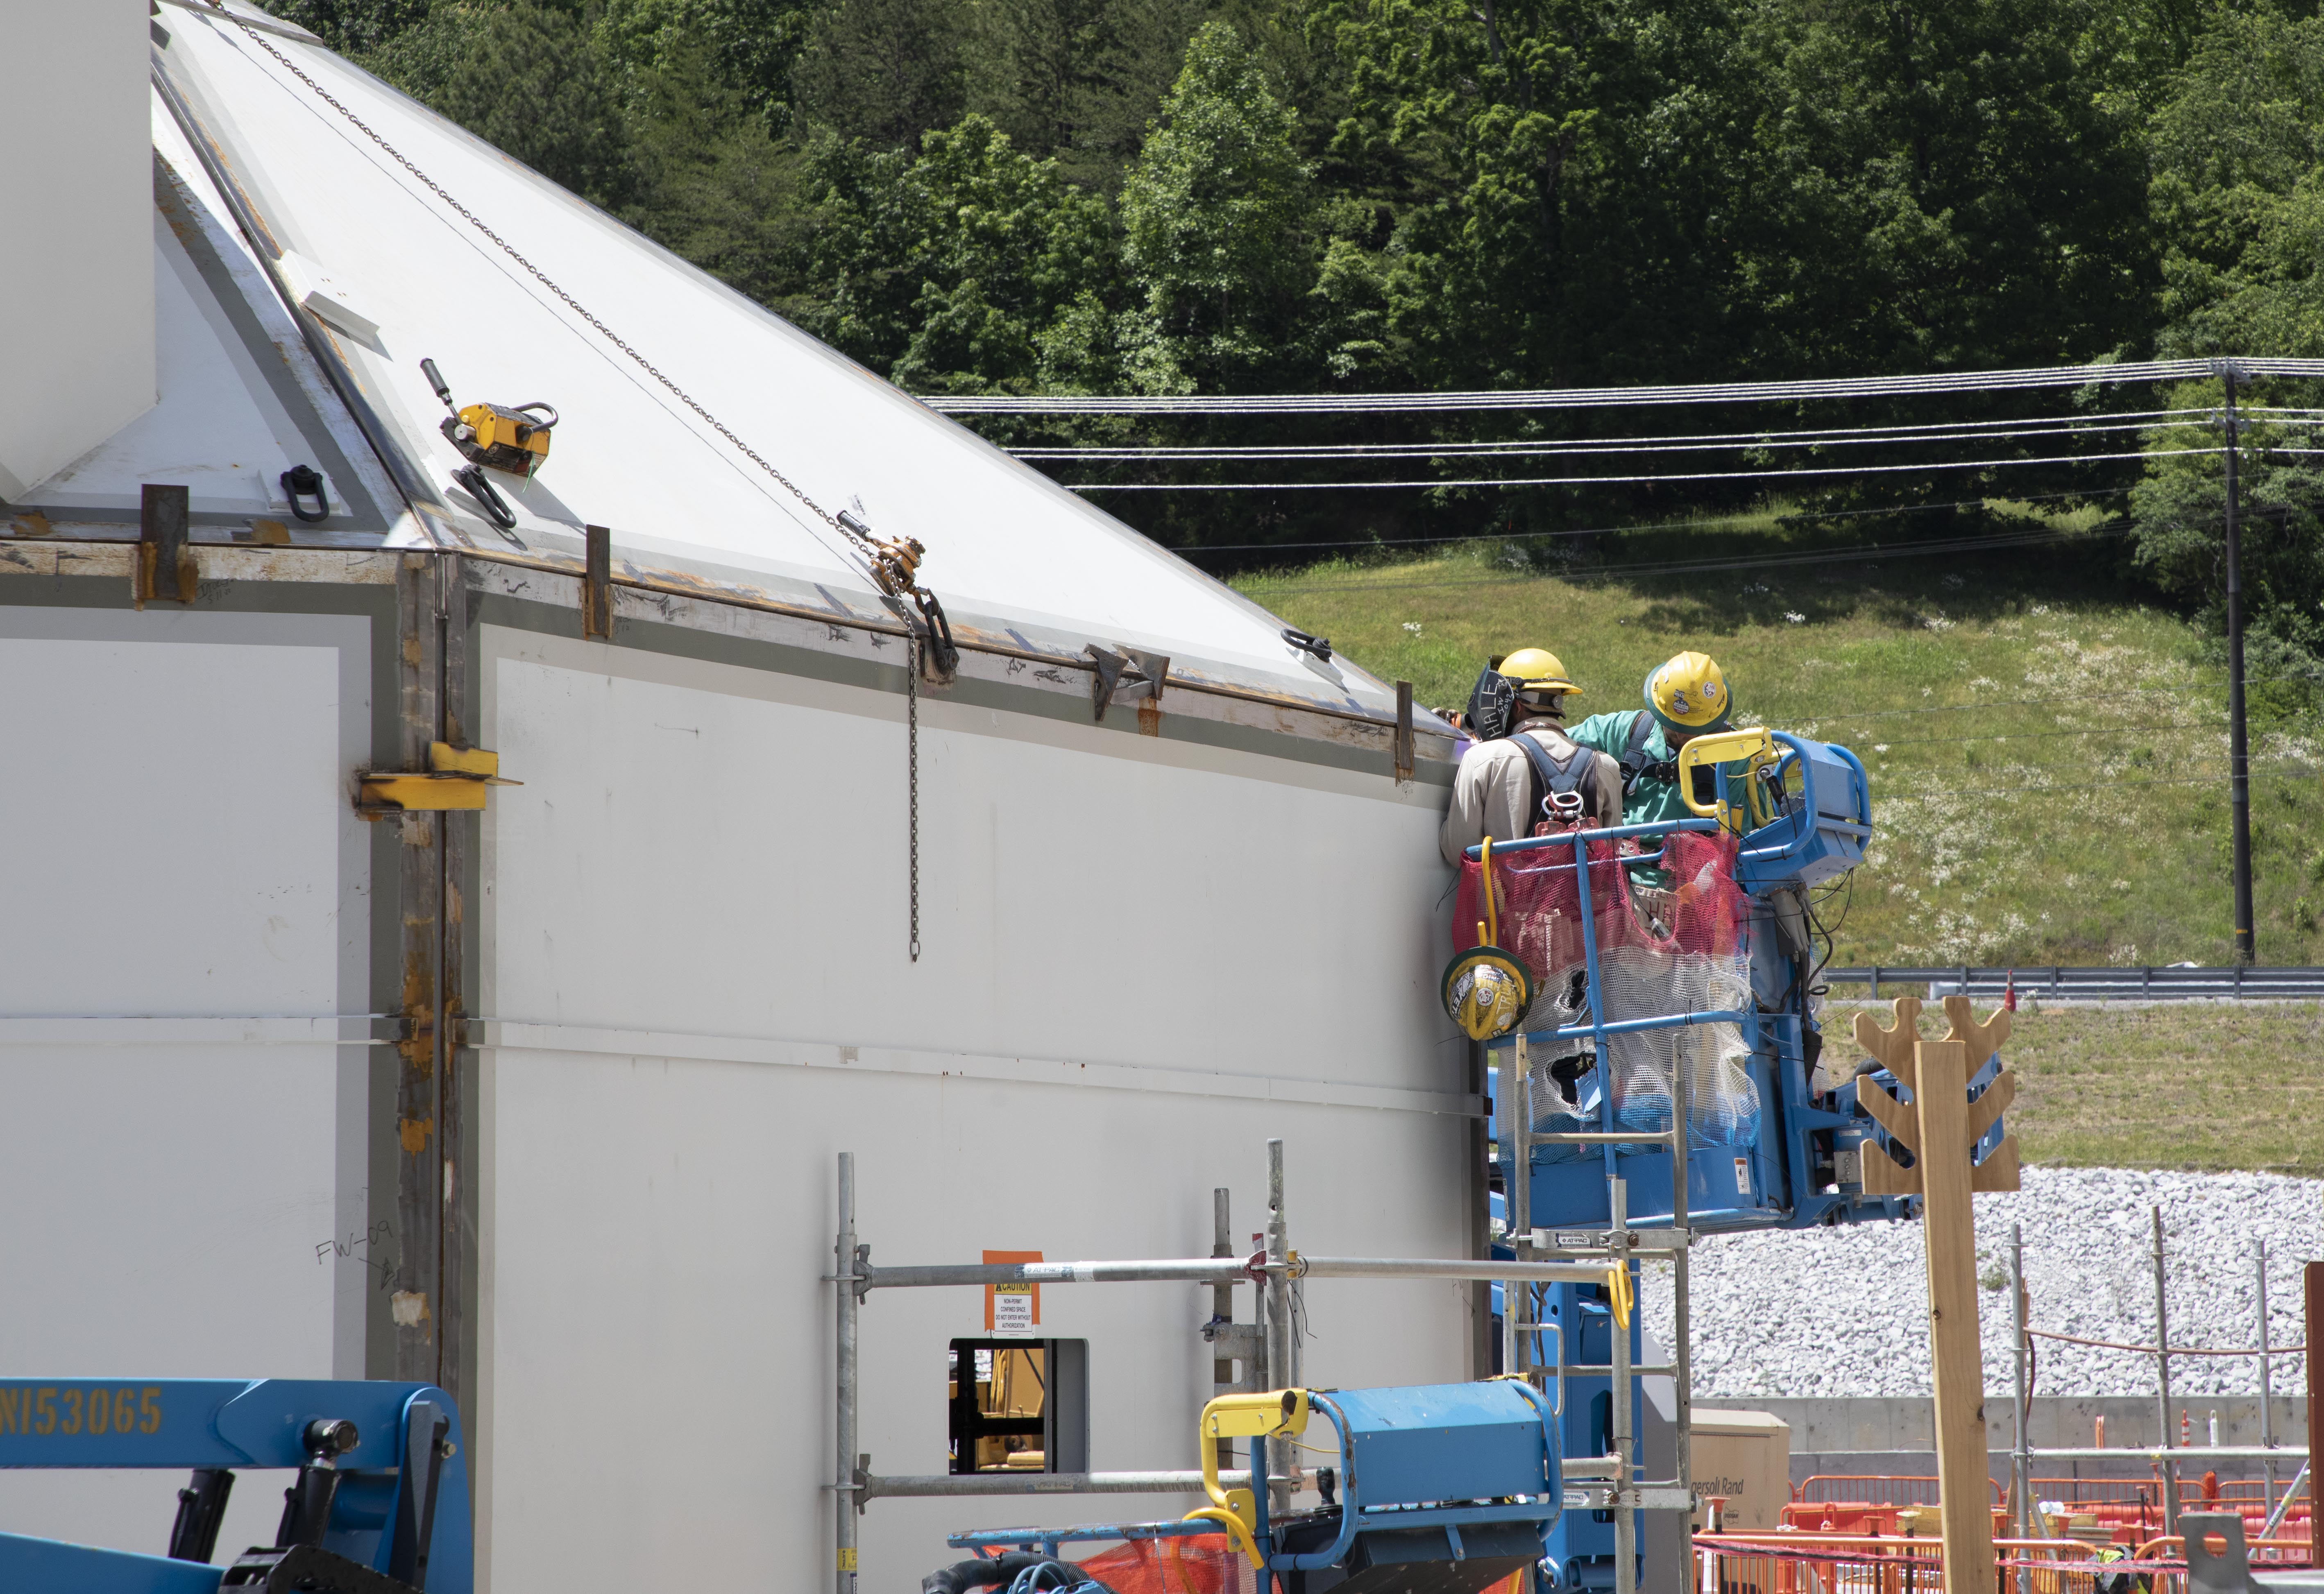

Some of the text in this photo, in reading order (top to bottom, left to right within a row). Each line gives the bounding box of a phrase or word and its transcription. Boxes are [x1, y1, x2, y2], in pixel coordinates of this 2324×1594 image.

[1481, 684, 1502, 737] HALE
[1497, 697, 1505, 714] IW
[316, 1220, 393, 1265] FW-09
[1002, 1282, 1030, 1291] CAUTION
[1722, 1477, 1744, 1494] Rand
